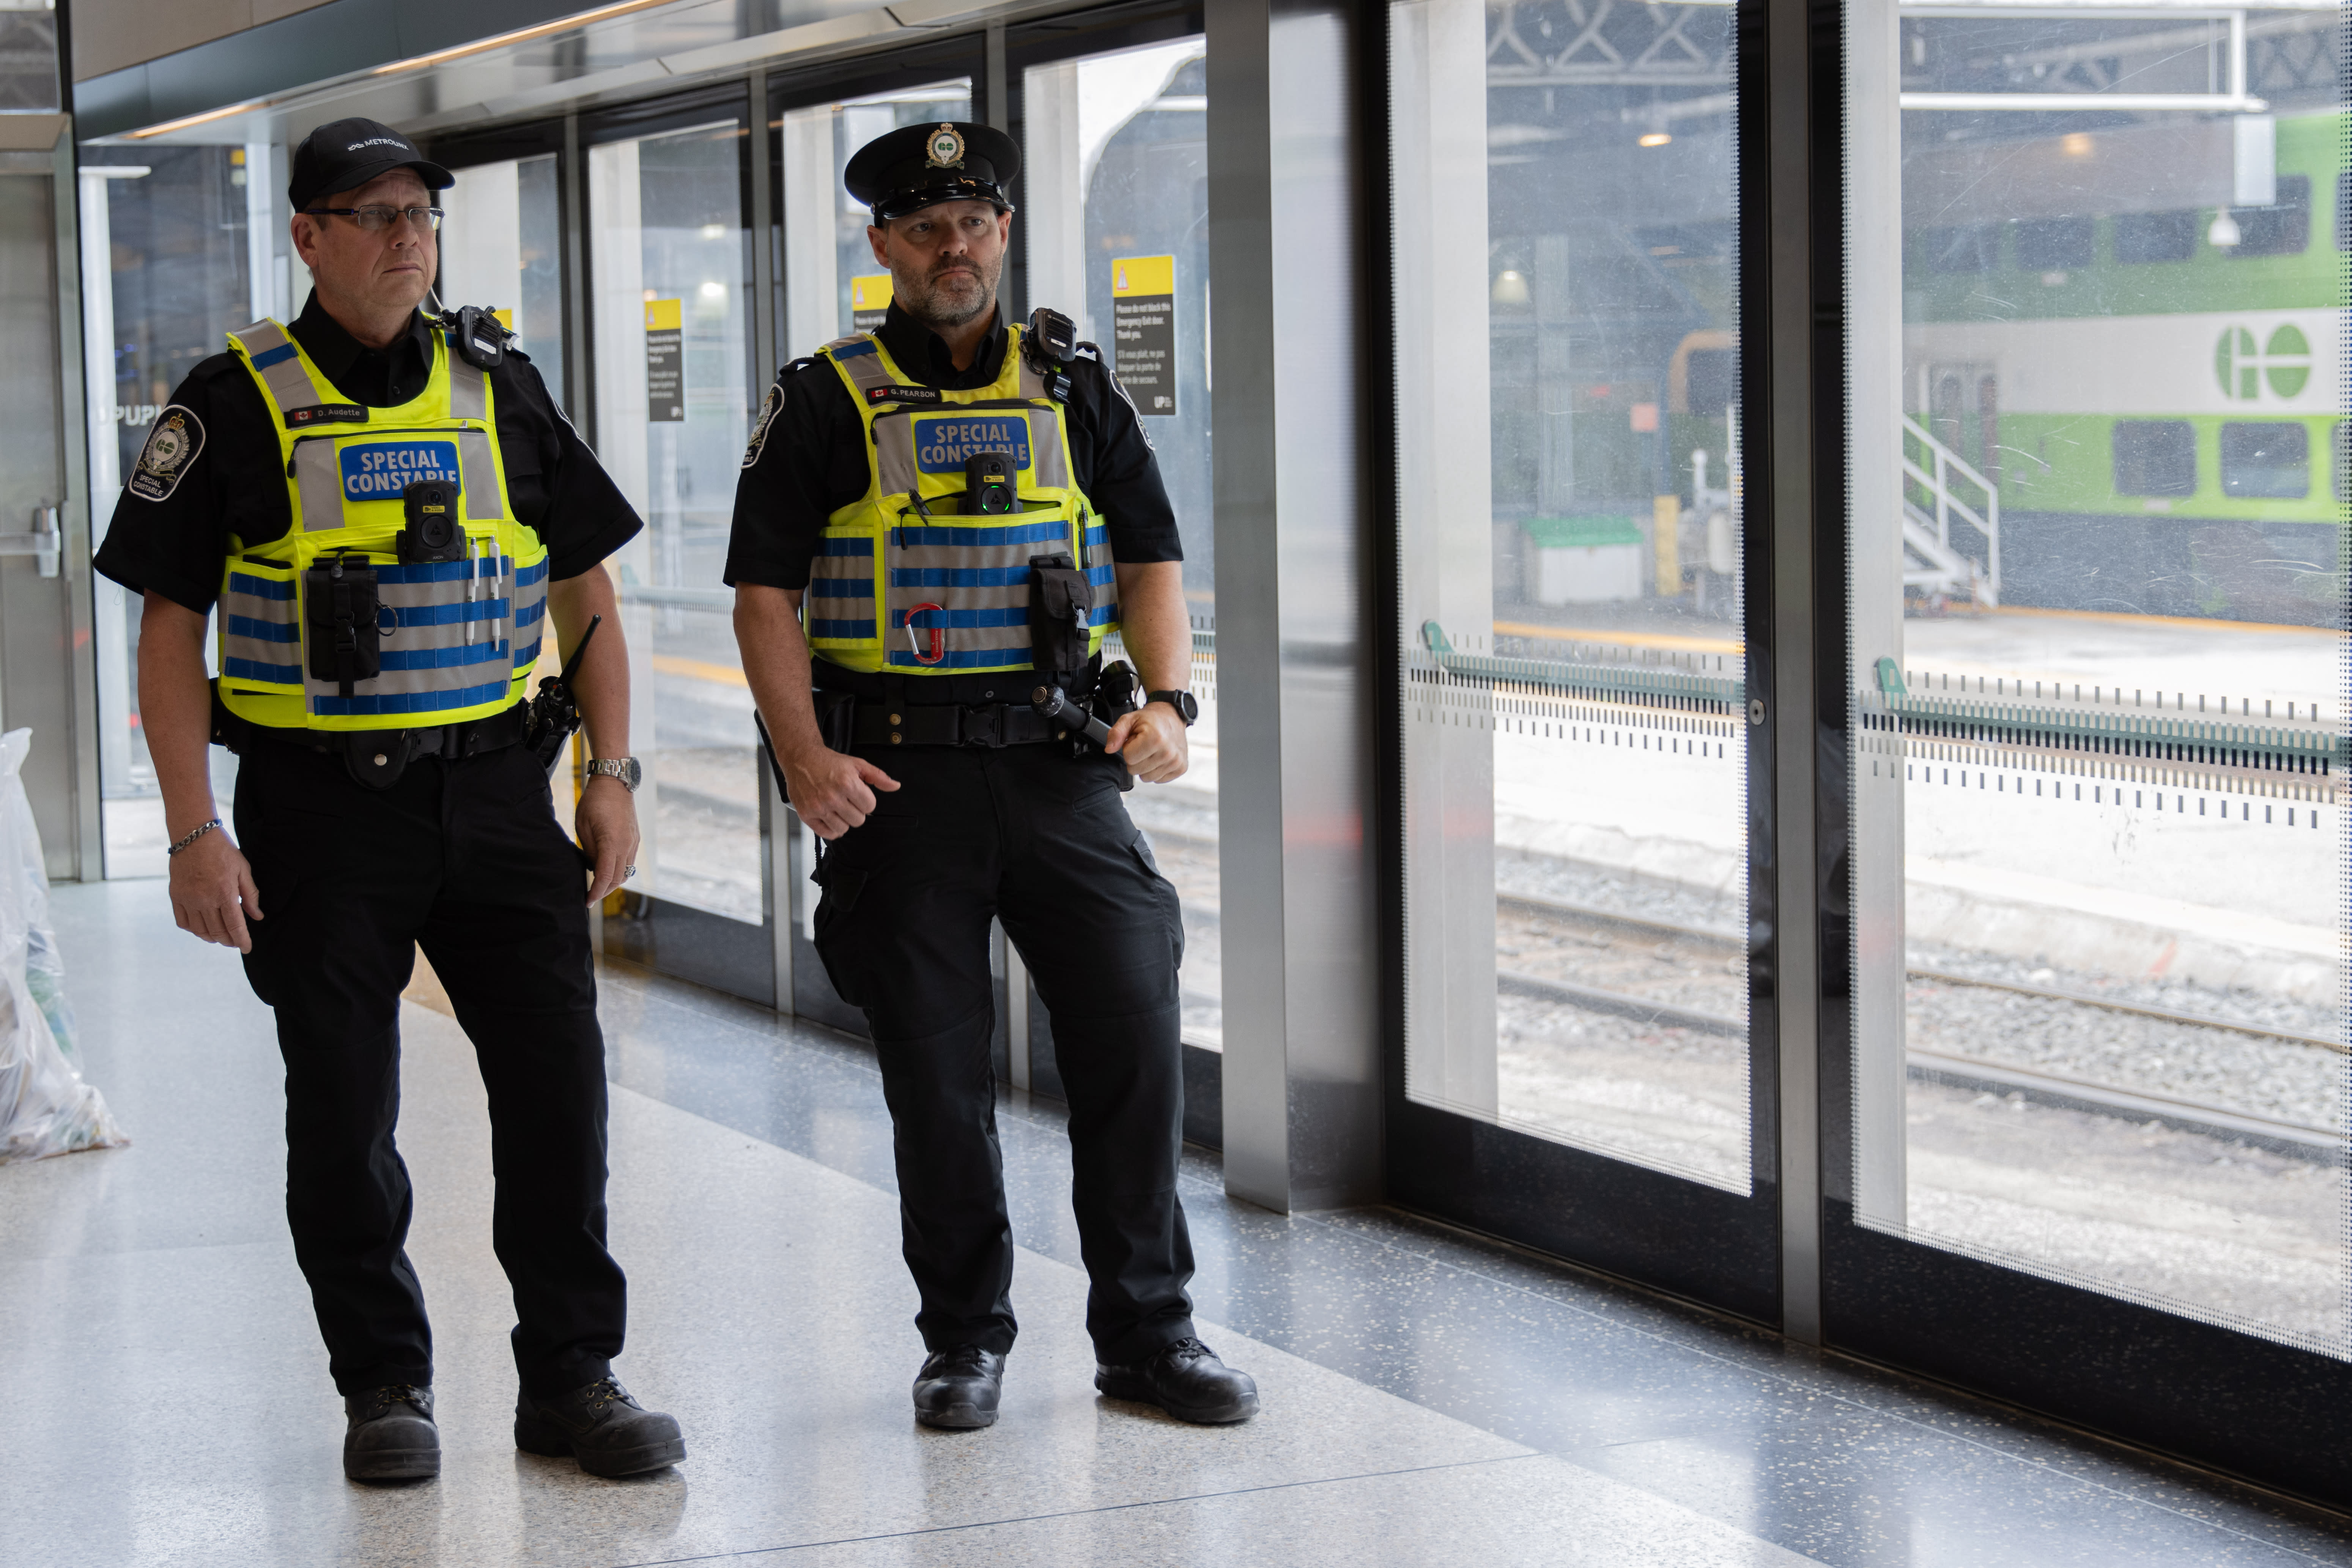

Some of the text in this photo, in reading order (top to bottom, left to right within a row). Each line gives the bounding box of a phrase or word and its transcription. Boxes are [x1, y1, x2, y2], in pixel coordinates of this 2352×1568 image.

[364, 139, 409, 150] METROLINX
[1116, 302, 1171, 314] Please do not block this
[1116, 317, 1142, 329] Emergency
[1116, 329, 1130, 339] Thank
[935, 424, 1010, 443] SPECIAL
[361, 450, 439, 471] SPECIAL
[140, 474, 161, 488] SPECIAL
[134, 481, 164, 496] CONSTABLE
